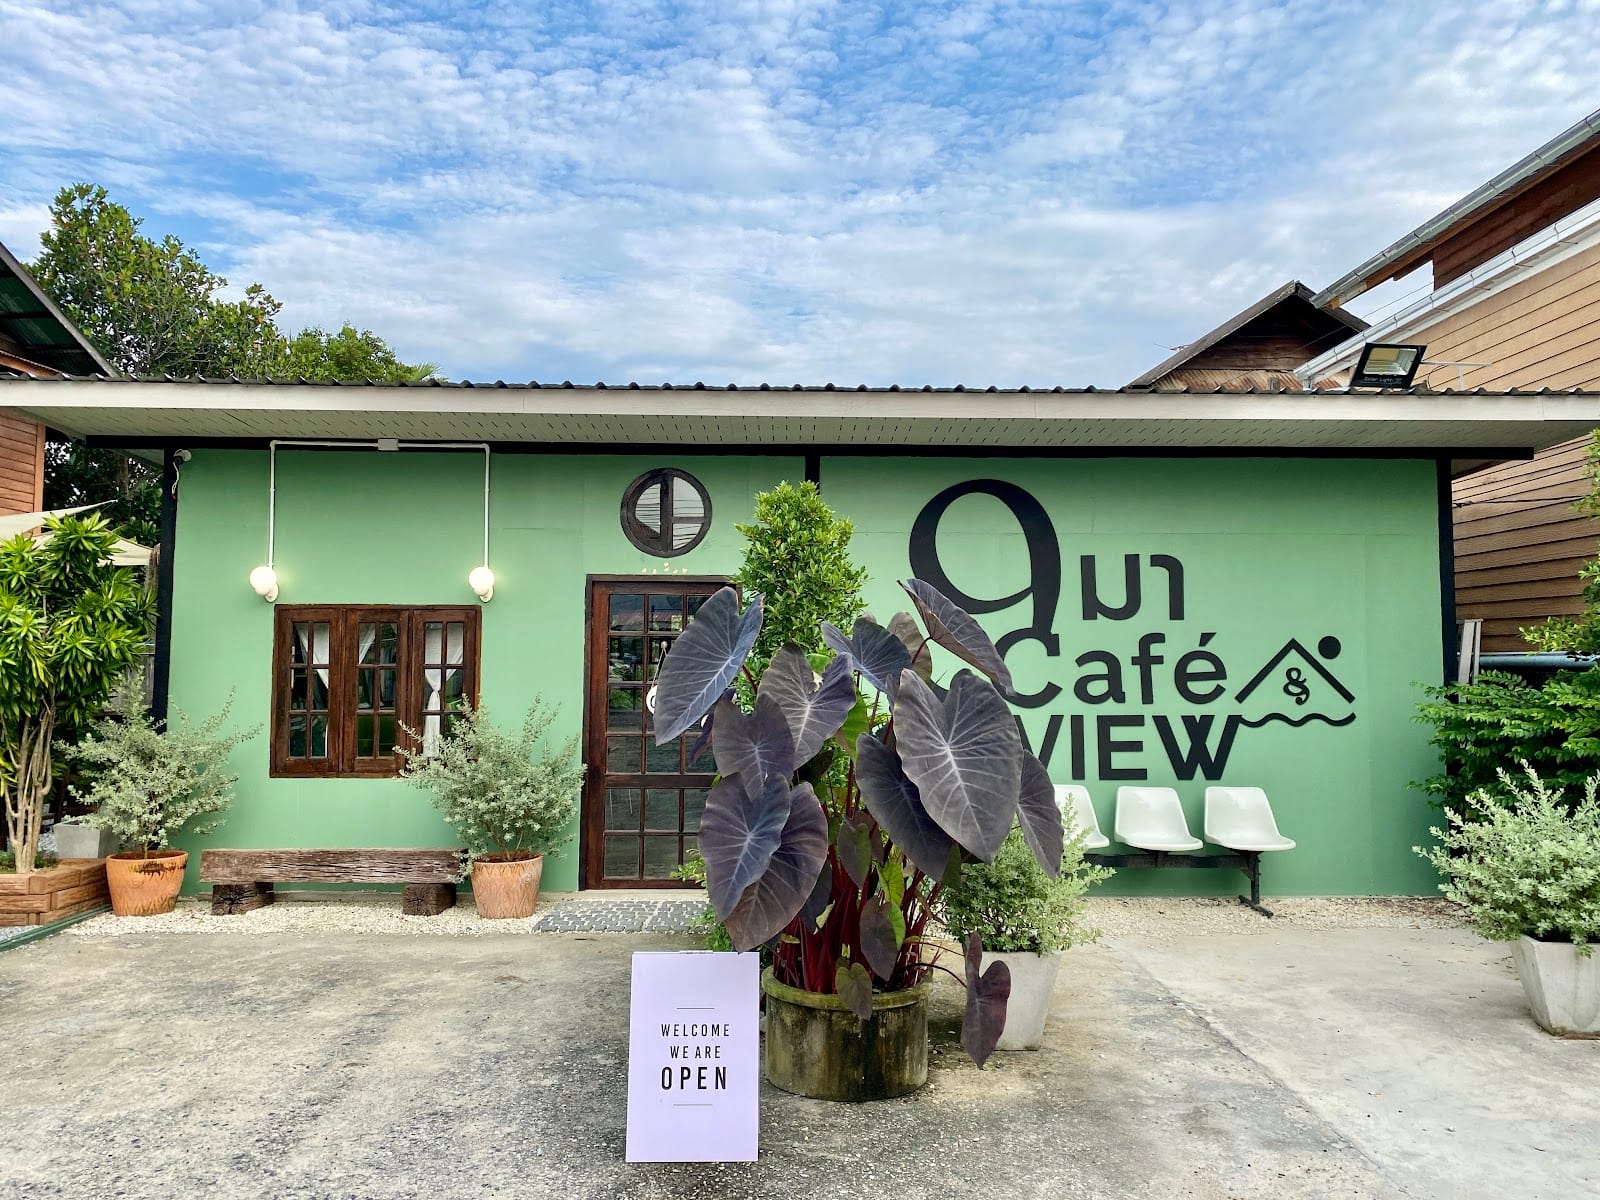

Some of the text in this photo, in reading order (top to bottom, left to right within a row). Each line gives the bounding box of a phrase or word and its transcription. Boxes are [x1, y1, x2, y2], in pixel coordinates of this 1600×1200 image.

[995, 628, 1228, 708] Café
[1013, 714, 1242, 781] VIEW
[661, 1023, 730, 1037] WELCOME
[670, 1045, 720, 1059] WE ARE
[661, 1066, 727, 1090] OPEN
